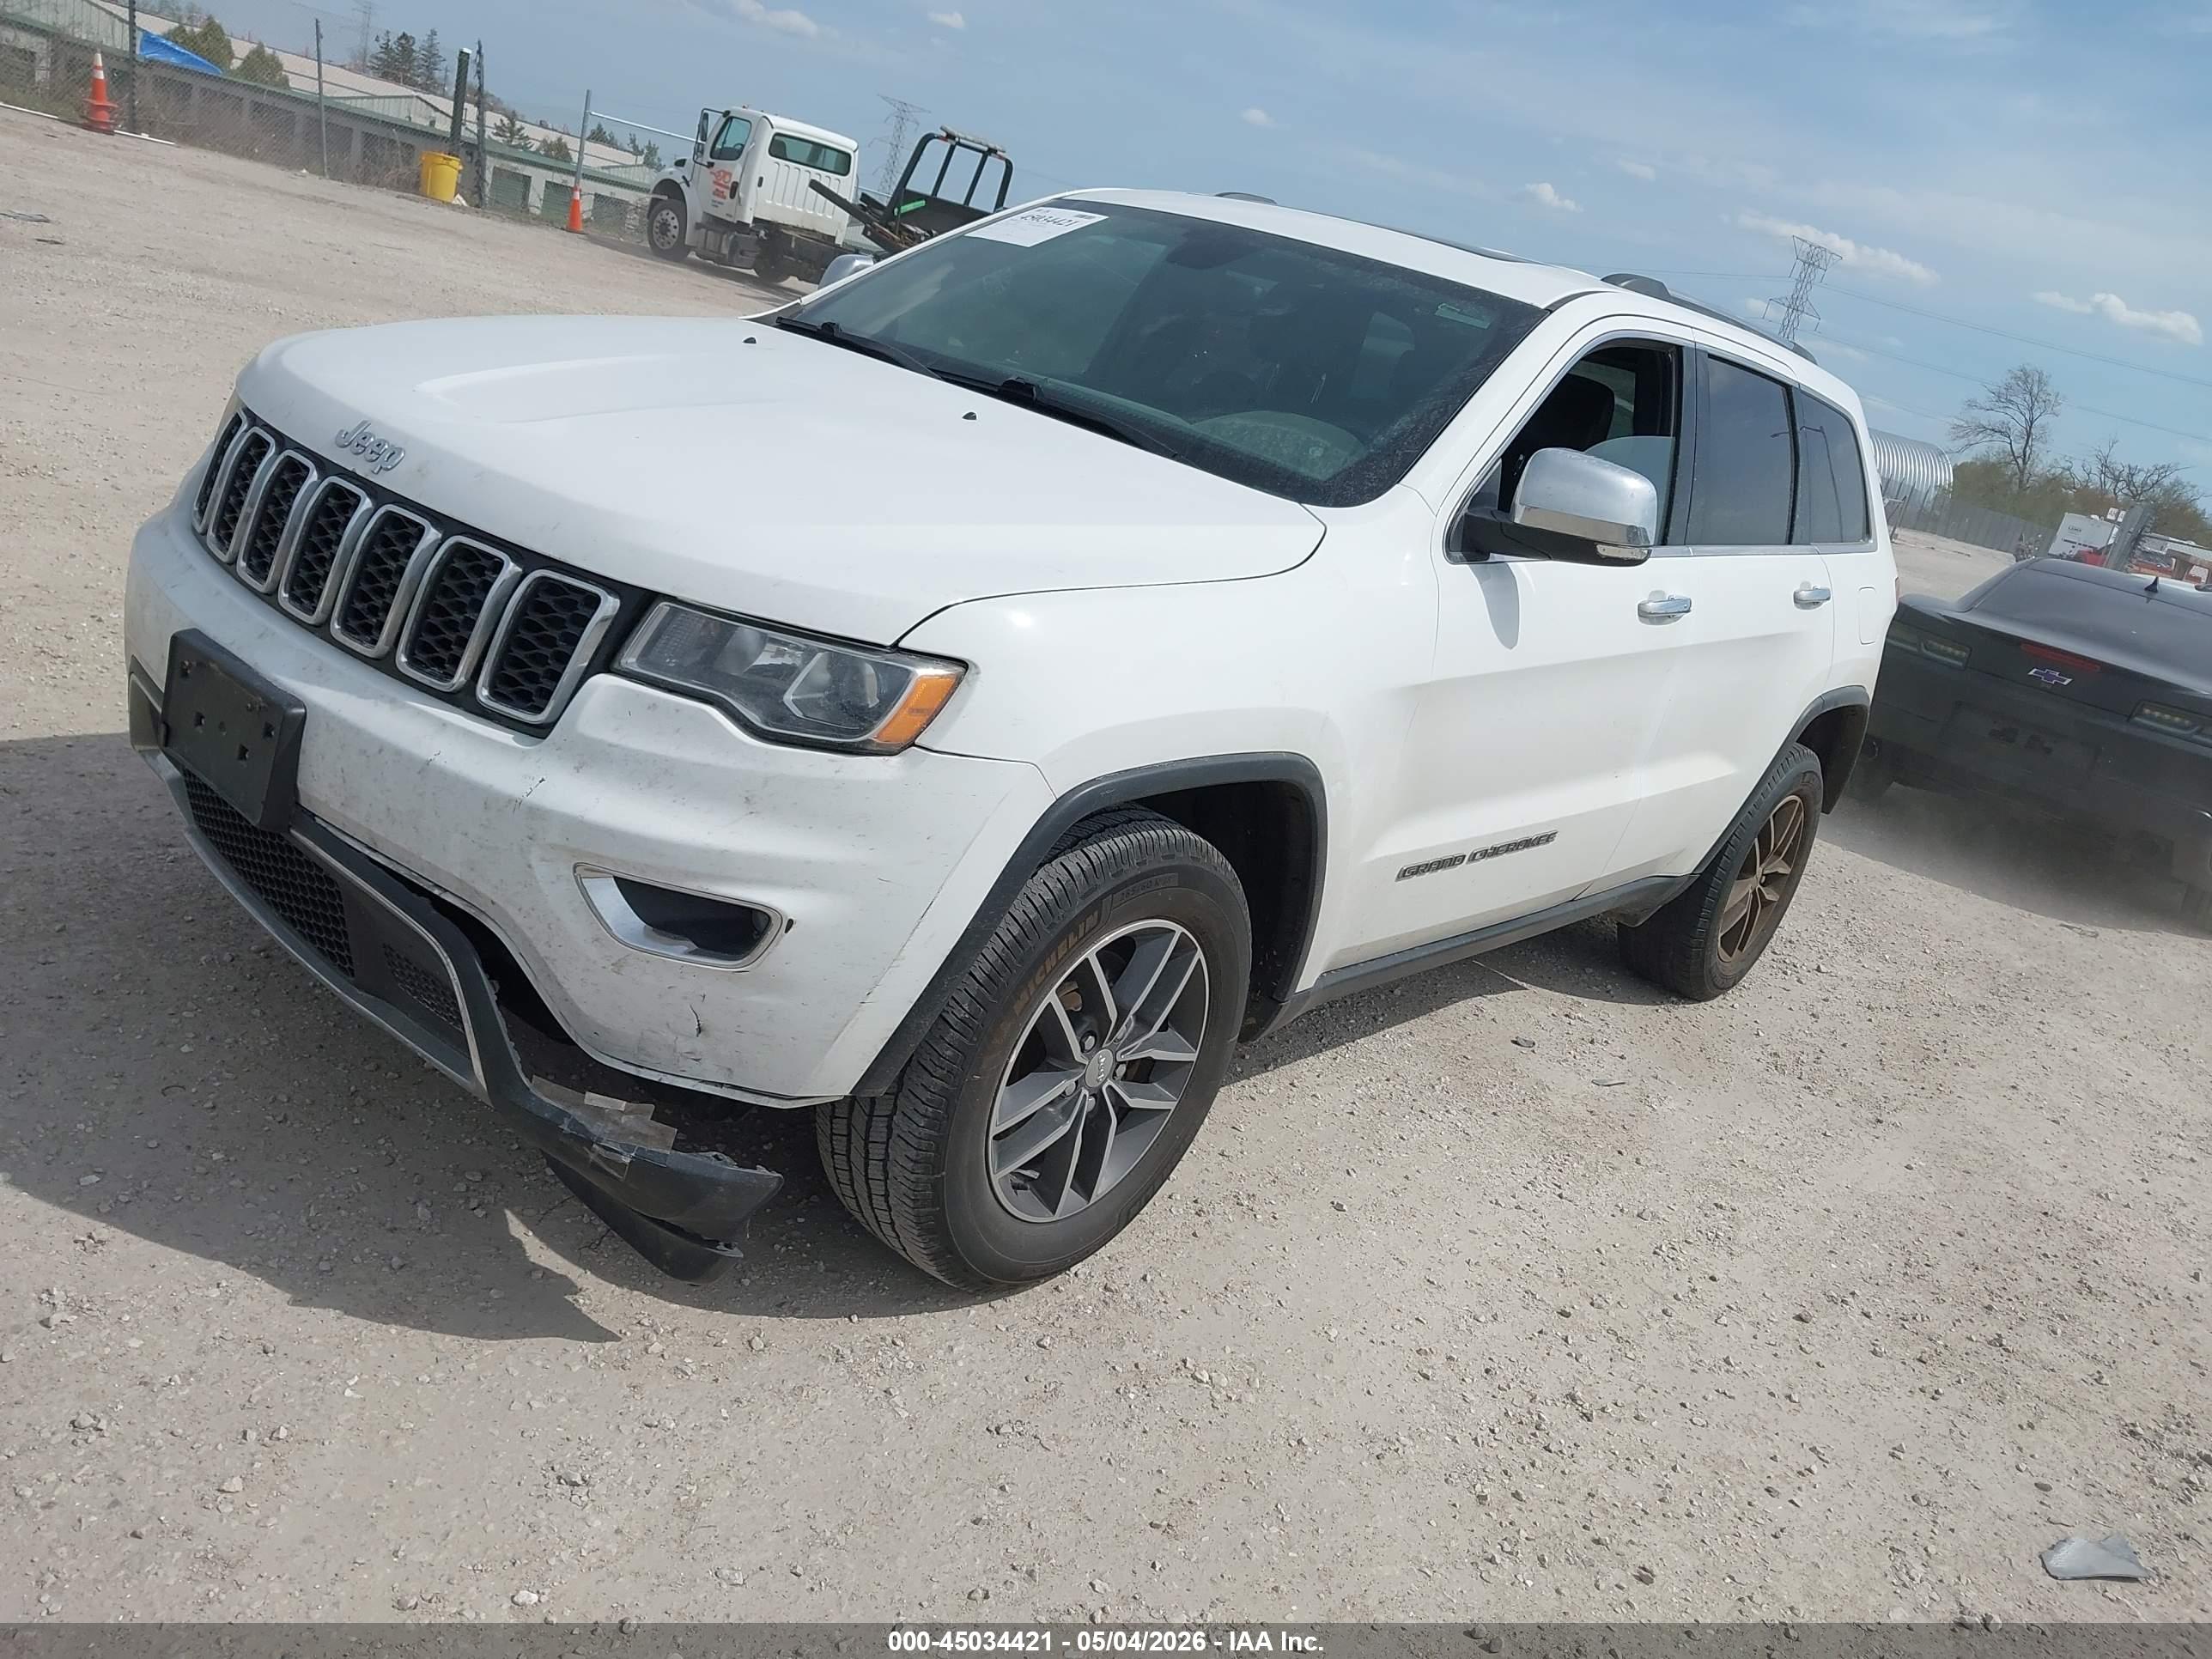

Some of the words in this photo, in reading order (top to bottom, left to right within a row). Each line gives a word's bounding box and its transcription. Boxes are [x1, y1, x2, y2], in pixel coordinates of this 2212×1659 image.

[335, 419, 406, 475] Jeep
[1395, 853, 1467, 883] GRAND
[1465, 830, 1559, 866] CHEROKEE
